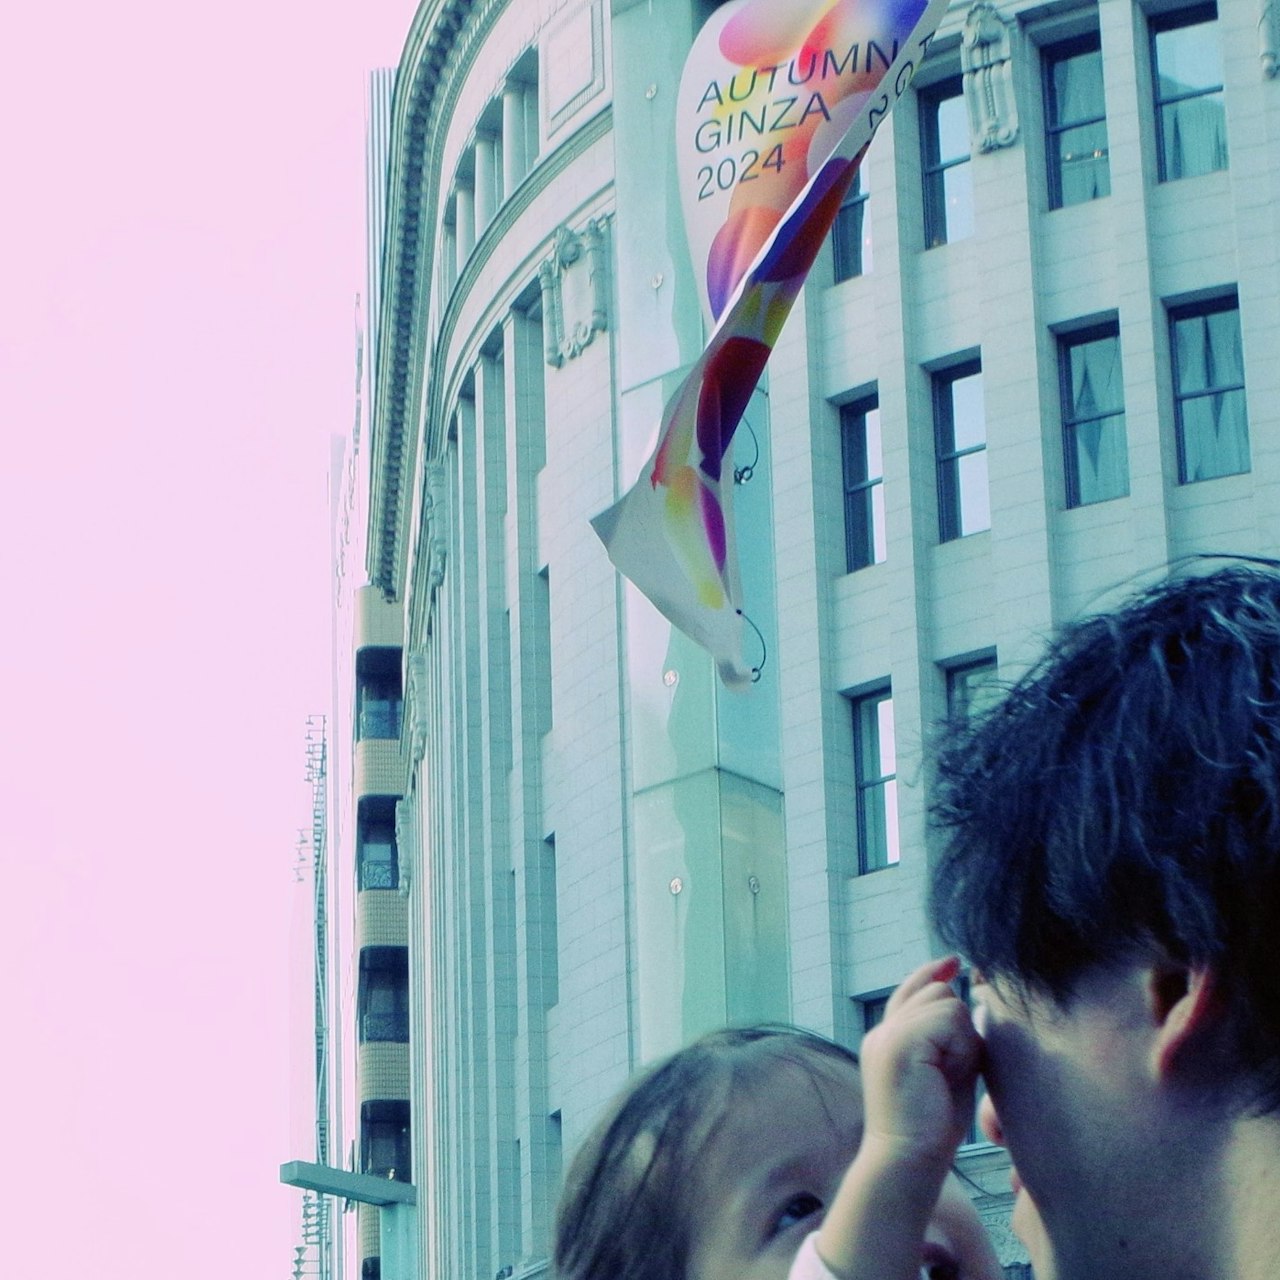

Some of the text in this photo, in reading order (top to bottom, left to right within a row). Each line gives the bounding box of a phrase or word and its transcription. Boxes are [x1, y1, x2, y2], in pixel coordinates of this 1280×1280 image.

[695, 38, 899, 114] AUTUMN
[694, 91, 832, 153] GINZA
[697, 142, 786, 202] 2024
